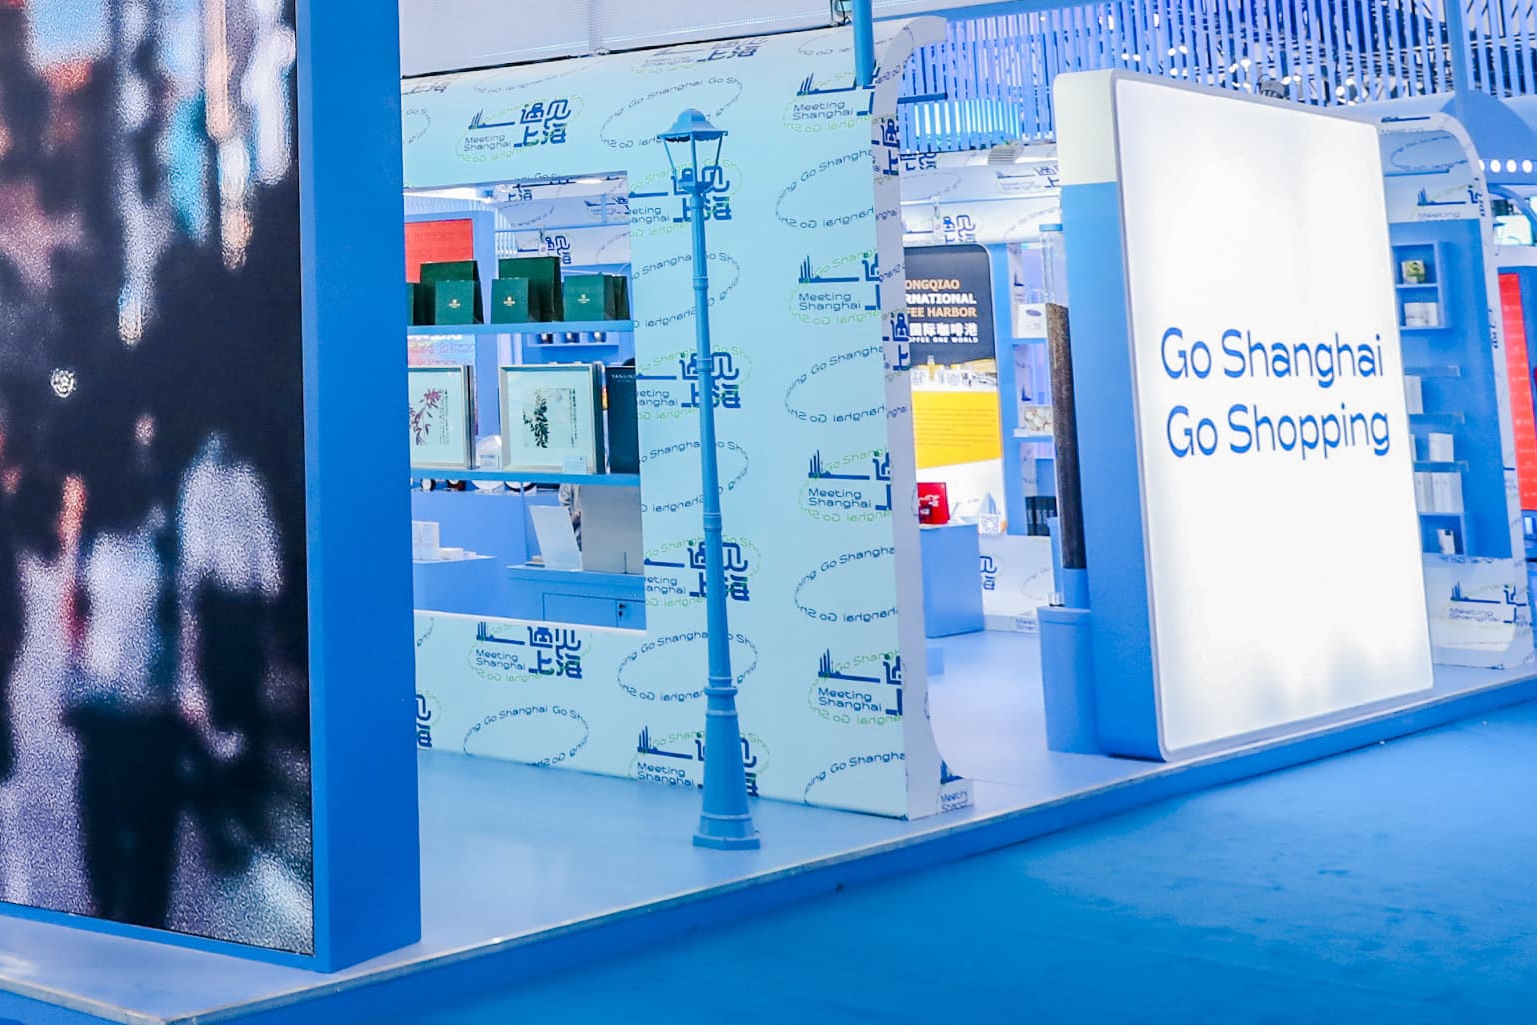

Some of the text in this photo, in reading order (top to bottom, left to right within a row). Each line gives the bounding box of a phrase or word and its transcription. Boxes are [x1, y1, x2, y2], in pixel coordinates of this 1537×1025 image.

[793, 101, 846, 112] Meeting
[793, 108, 854, 121] Shanghai
[463, 140, 512, 152] Shanghai
[464, 134, 506, 145] Meeting
[798, 292, 852, 303] Meeting
[798, 301, 861, 312] Shanghai
[927, 307, 978, 318] HARBOR
[1161, 326, 1384, 388] Go Shanghai
[1167, 403, 1390, 461] Go Shopping
[808, 487, 863, 501] Meeting
[808, 496, 873, 510] Shanghai
[820, 560, 838, 573] Go
[640, 641, 656, 654] Go
[657, 630, 709, 647] Shangha
[476, 648, 519, 662] Meeting
[475, 657, 527, 671] Shanghai
[818, 686, 873, 703] Meeting
[818, 696, 883, 713] Shanghai
[499, 705, 548, 720] Shanghai
[552, 705, 568, 716] Go
[637, 761, 686, 777] Meeting
[830, 762, 847, 774] Go
